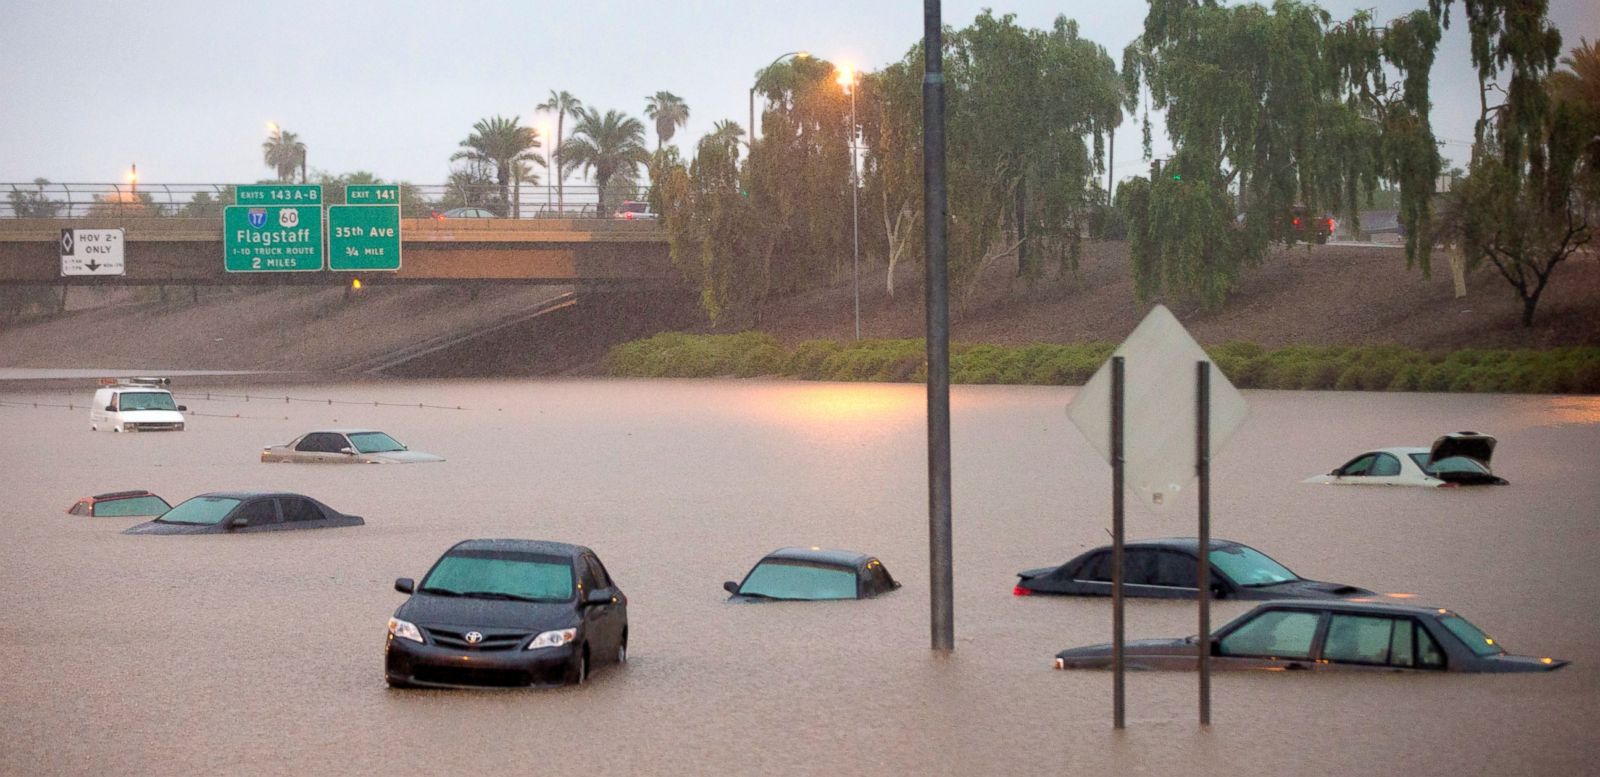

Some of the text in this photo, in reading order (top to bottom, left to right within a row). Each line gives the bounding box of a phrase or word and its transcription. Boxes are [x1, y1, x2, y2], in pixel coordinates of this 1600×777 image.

[271, 190, 292, 200] 143
[294, 190, 318, 200] A-B
[376, 190, 396, 200] 141
[252, 212, 296, 225] 17 60
[236, 229, 310, 245] Flagstaff
[335, 227, 394, 238] 35th Ave
[364, 248, 384, 256] MILE
[252, 257, 296, 268] 2 MILES
